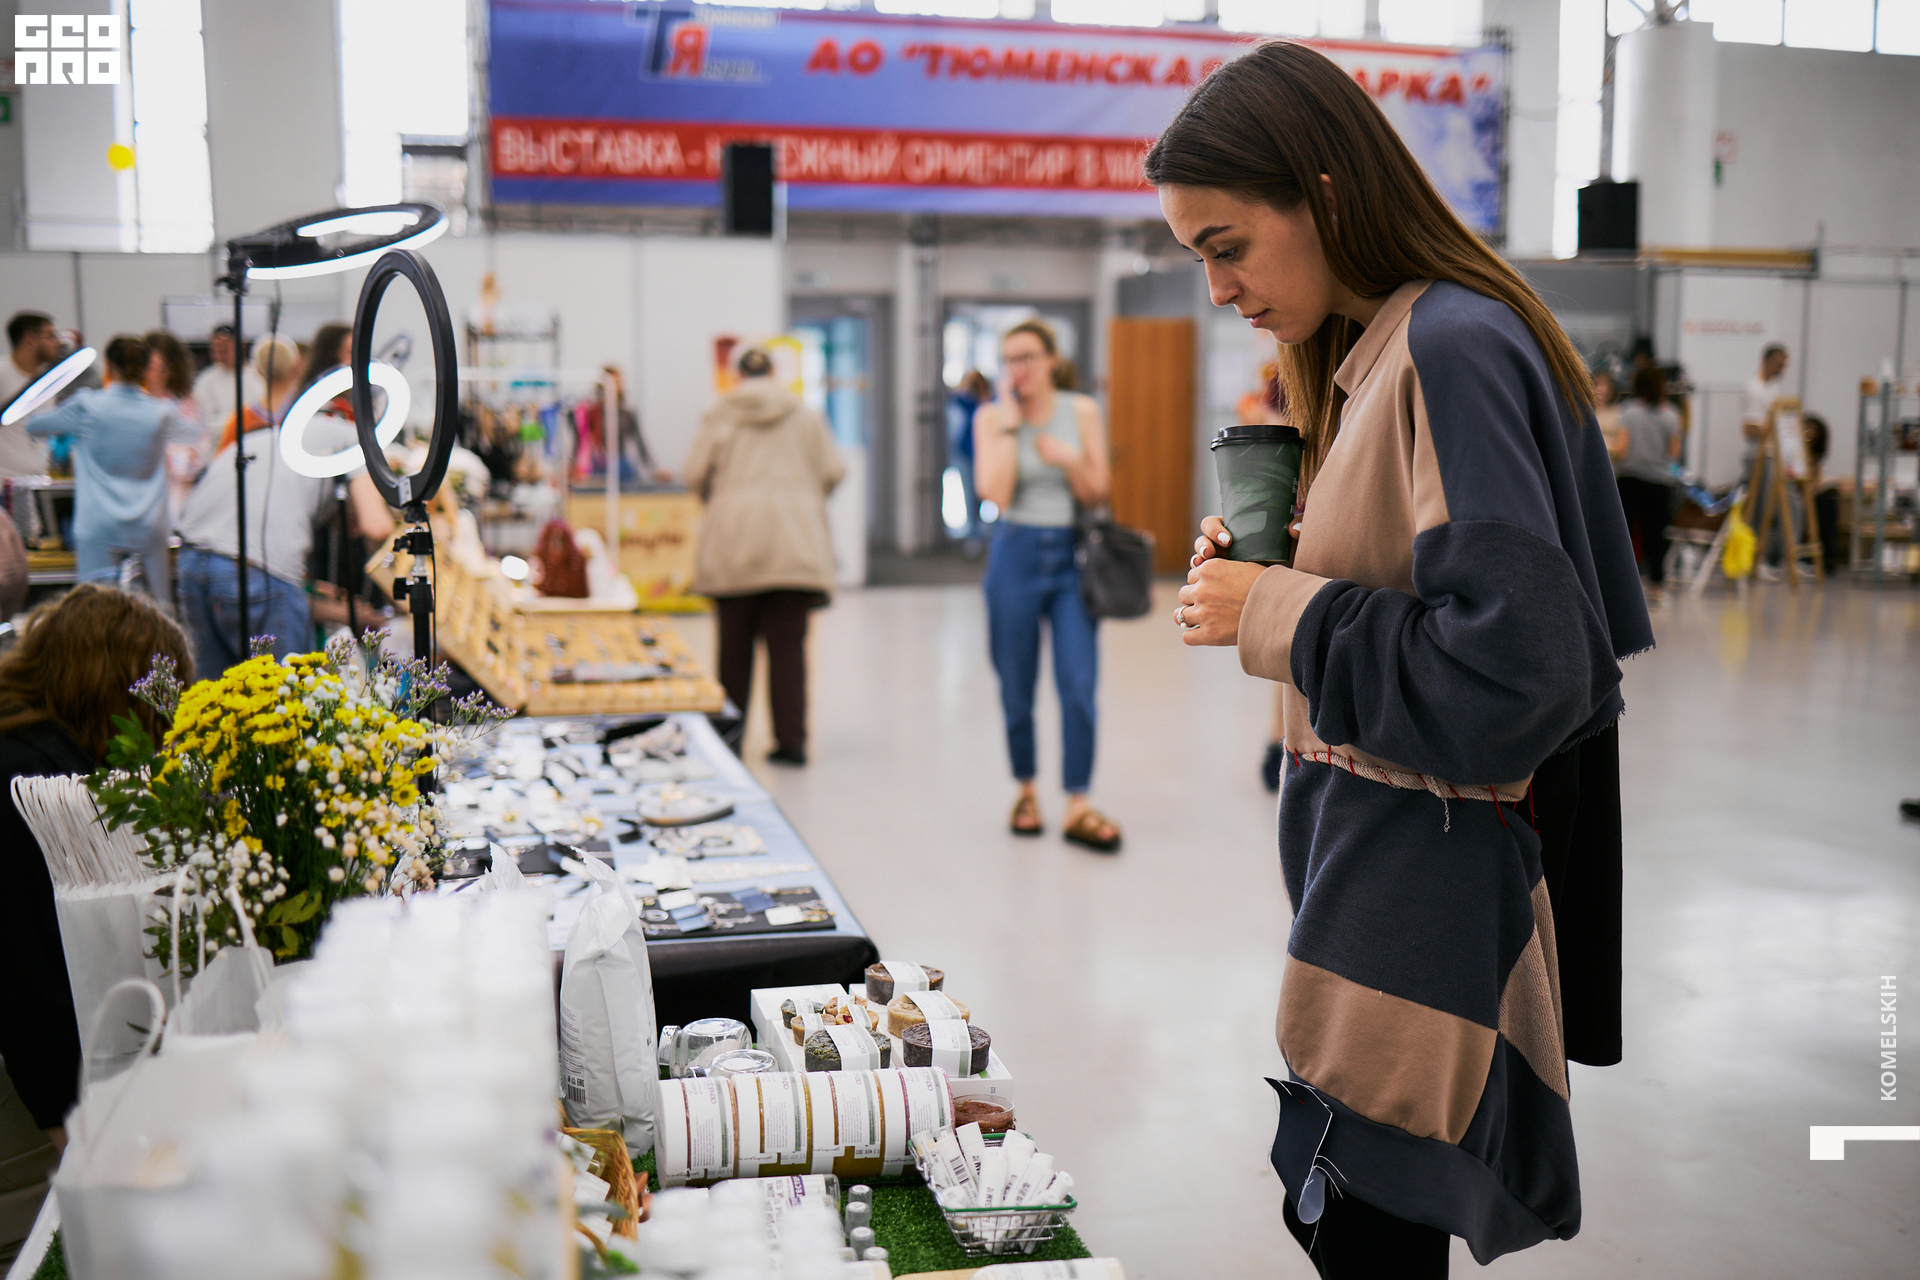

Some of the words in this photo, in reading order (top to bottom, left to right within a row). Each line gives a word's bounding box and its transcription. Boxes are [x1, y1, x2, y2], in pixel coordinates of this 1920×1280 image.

[807, 38, 884, 76] АО
[498, 126, 687, 176] ВЫСТАВКА
[704, 131, 899, 181] НЕЖНЫЙ
[902, 138, 1074, 185] ОРИЕНТИР
